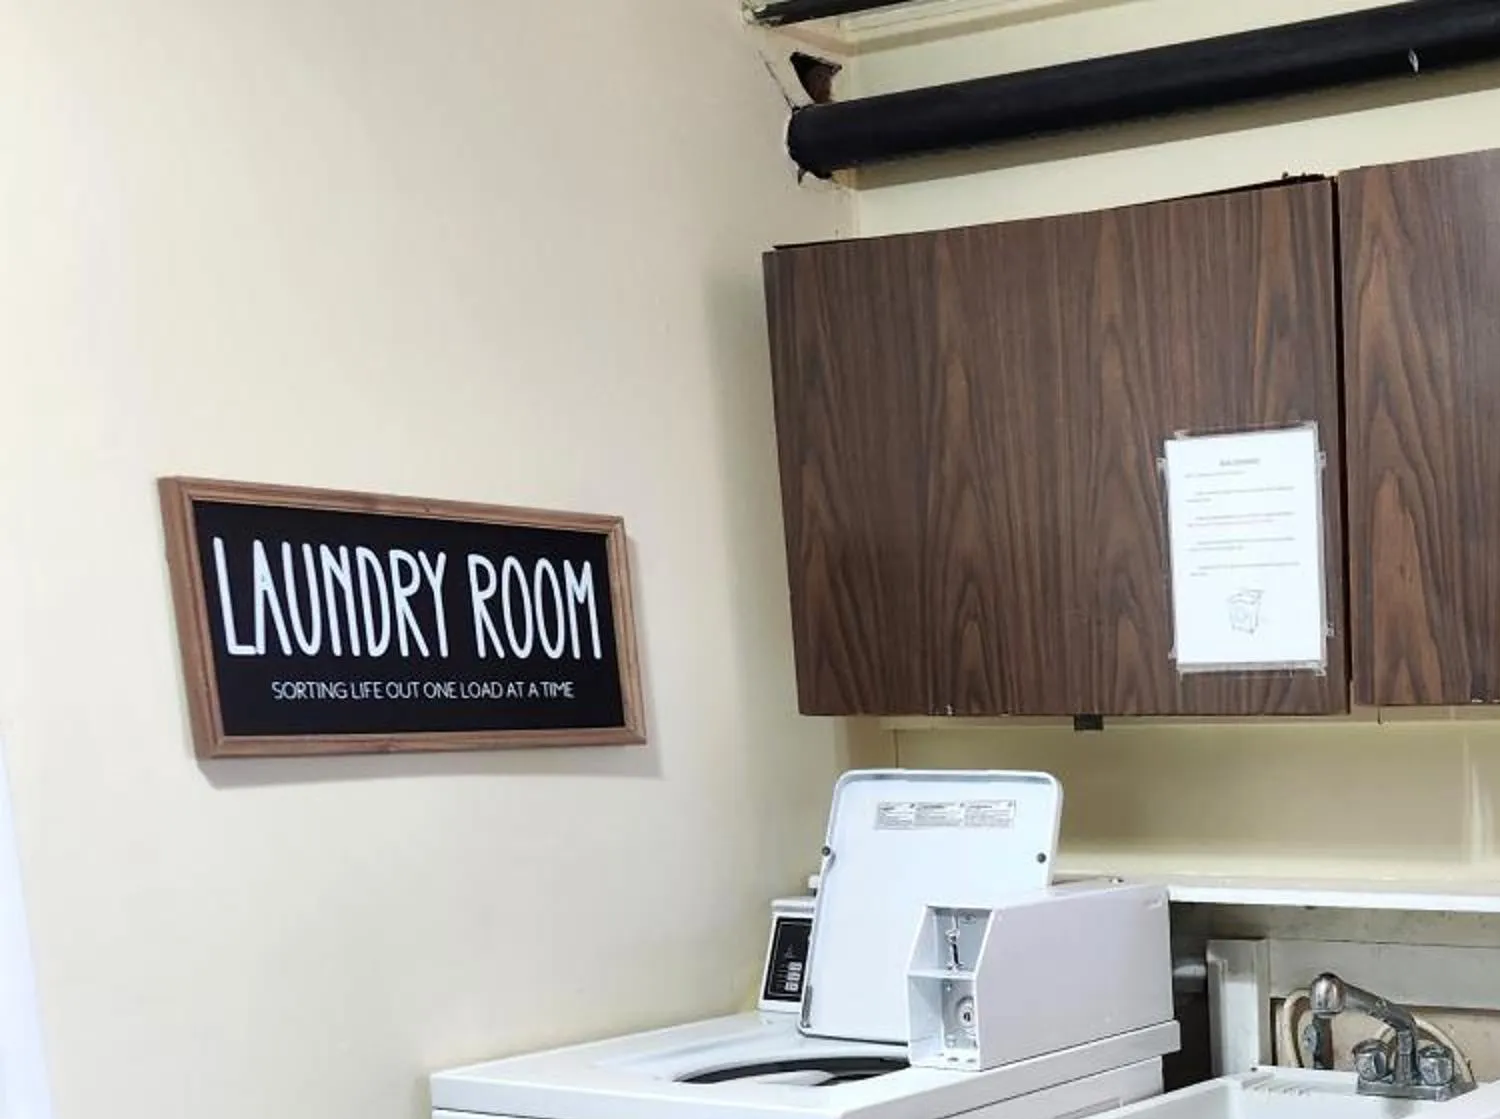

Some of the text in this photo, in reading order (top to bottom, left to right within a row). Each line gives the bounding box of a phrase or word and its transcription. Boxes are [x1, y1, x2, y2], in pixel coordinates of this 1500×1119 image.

[212, 536, 603, 659] LAUNDRY ROOM
[271, 681, 575, 699] SORTING LIFE OUT ONE LOAD AT A TIME
